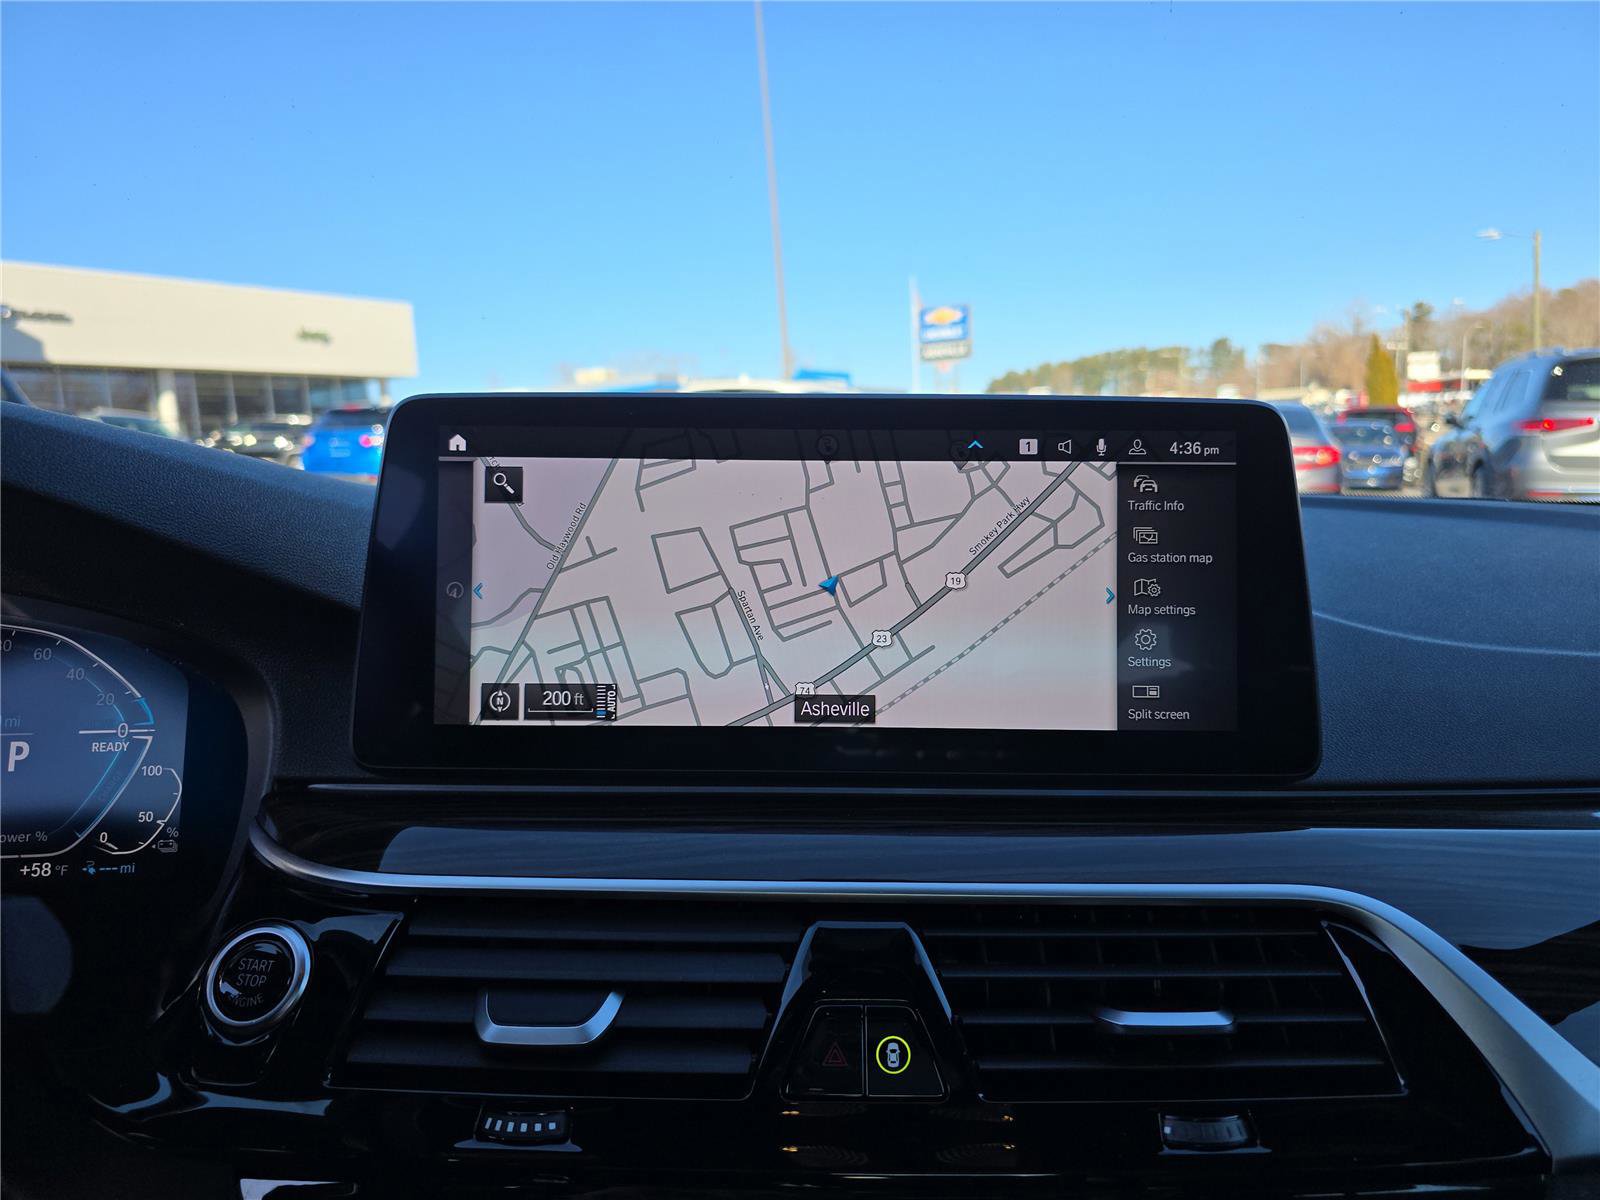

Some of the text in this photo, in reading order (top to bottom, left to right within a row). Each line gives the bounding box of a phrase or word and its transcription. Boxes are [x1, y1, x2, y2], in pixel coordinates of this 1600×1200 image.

[1024, 441, 1031, 452] 1
[1169, 441, 1220, 457] 4:36 pm
[1128, 500, 1185, 511] Traffic Info
[969, 496, 1031, 556] Smokey Park Hwy
[546, 502, 587, 570] Old Haywood Rd
[1127, 552, 1213, 565] Gas station map
[950, 576, 962, 587] 19
[737, 590, 764, 641] Spartan Ave
[1128, 604, 1196, 617] Map settings
[876, 634, 888, 644] 23
[33, 647, 52, 661] 60
[1127, 656, 1172, 669] Settings
[66, 667, 85, 680] 40
[800, 686, 811, 695] 74
[96, 692, 115, 706] 20
[542, 690, 584, 706] 200 ft
[607, 690, 616, 713] AUTO
[800, 701, 870, 717] Asheville
[1128, 708, 1191, 721] Split screen
[4, 715, 22, 728] mi
[117, 723, 129, 738] 0
[91, 741, 130, 752] READY
[7, 740, 30, 772] P
[141, 765, 163, 776] 100
[138, 811, 154, 823] 50
[35, 830, 48, 842] %
[99, 831, 108, 844] 0
[166, 827, 179, 838] %
[19, 862, 52, 877] +58
[238, 958, 275, 972] START
[236, 973, 267, 988] STOP
